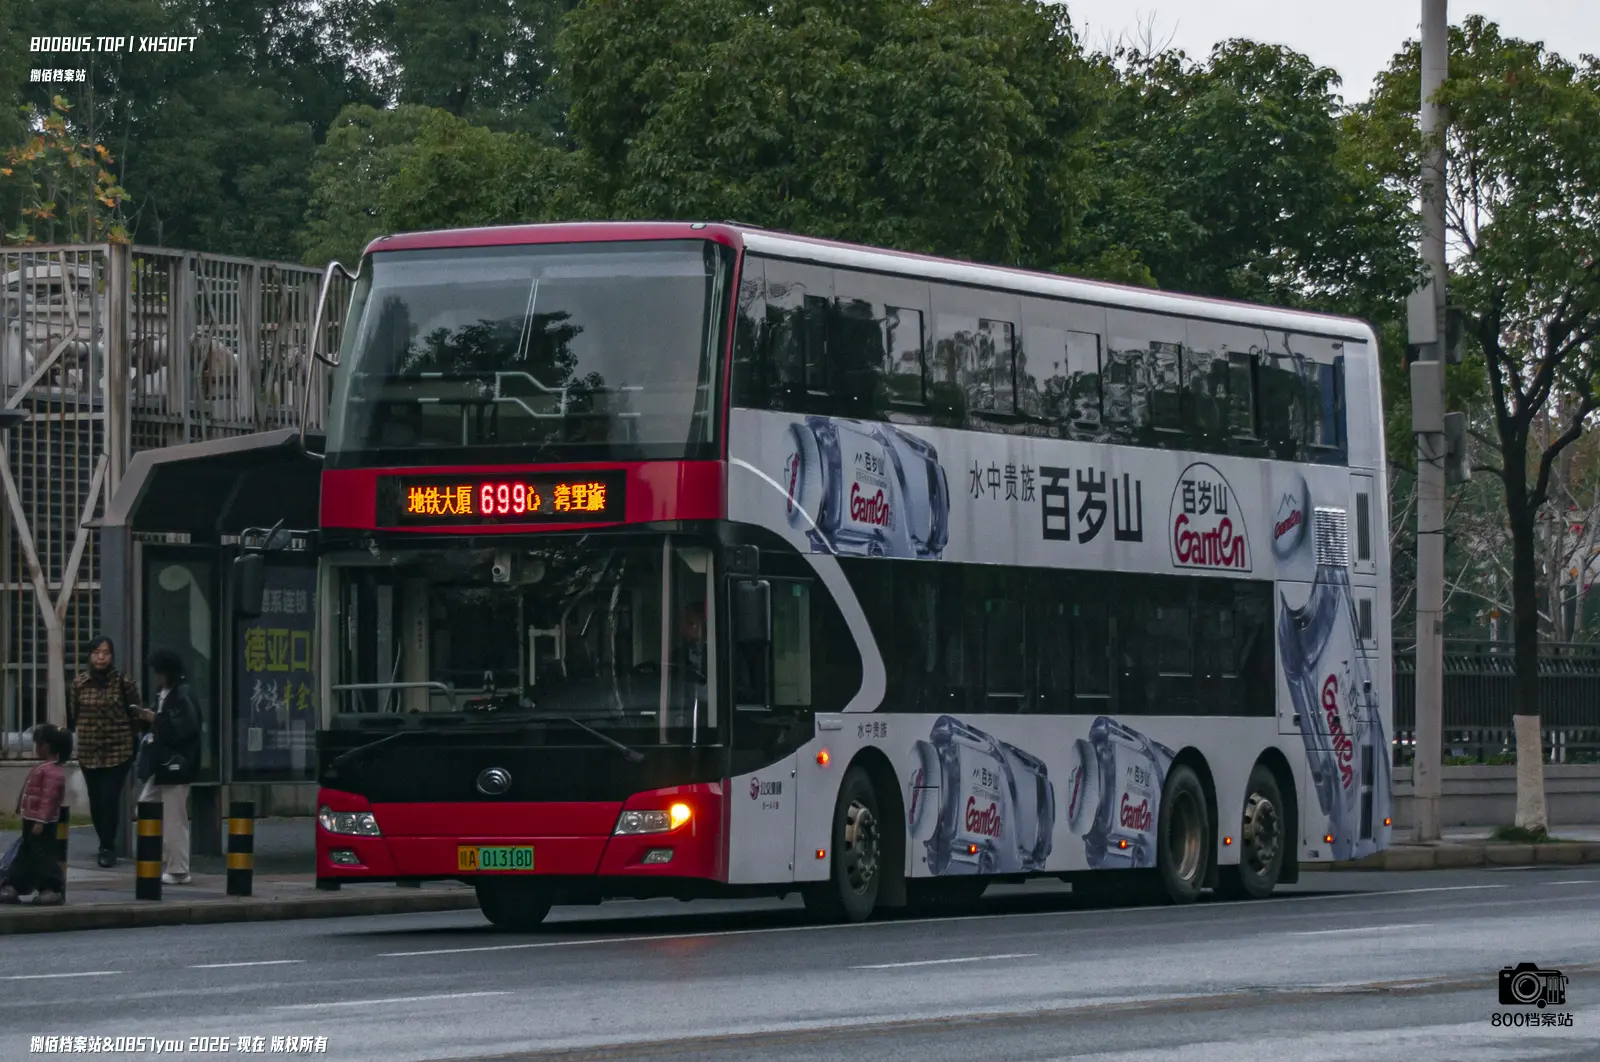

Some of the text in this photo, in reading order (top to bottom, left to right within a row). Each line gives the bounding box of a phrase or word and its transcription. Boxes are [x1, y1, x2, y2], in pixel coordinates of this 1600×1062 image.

[407, 485, 474, 515] 地铁大厦
[480, 483, 526, 514] 699
[969, 459, 1144, 545] 水中贵族 百岁山
[1181, 479, 1229, 516] 百岁山
[1174, 512, 1246, 568] Ganten
[244, 627, 312, 673] 德亚口
[857, 720, 888, 739] 水中贵族
